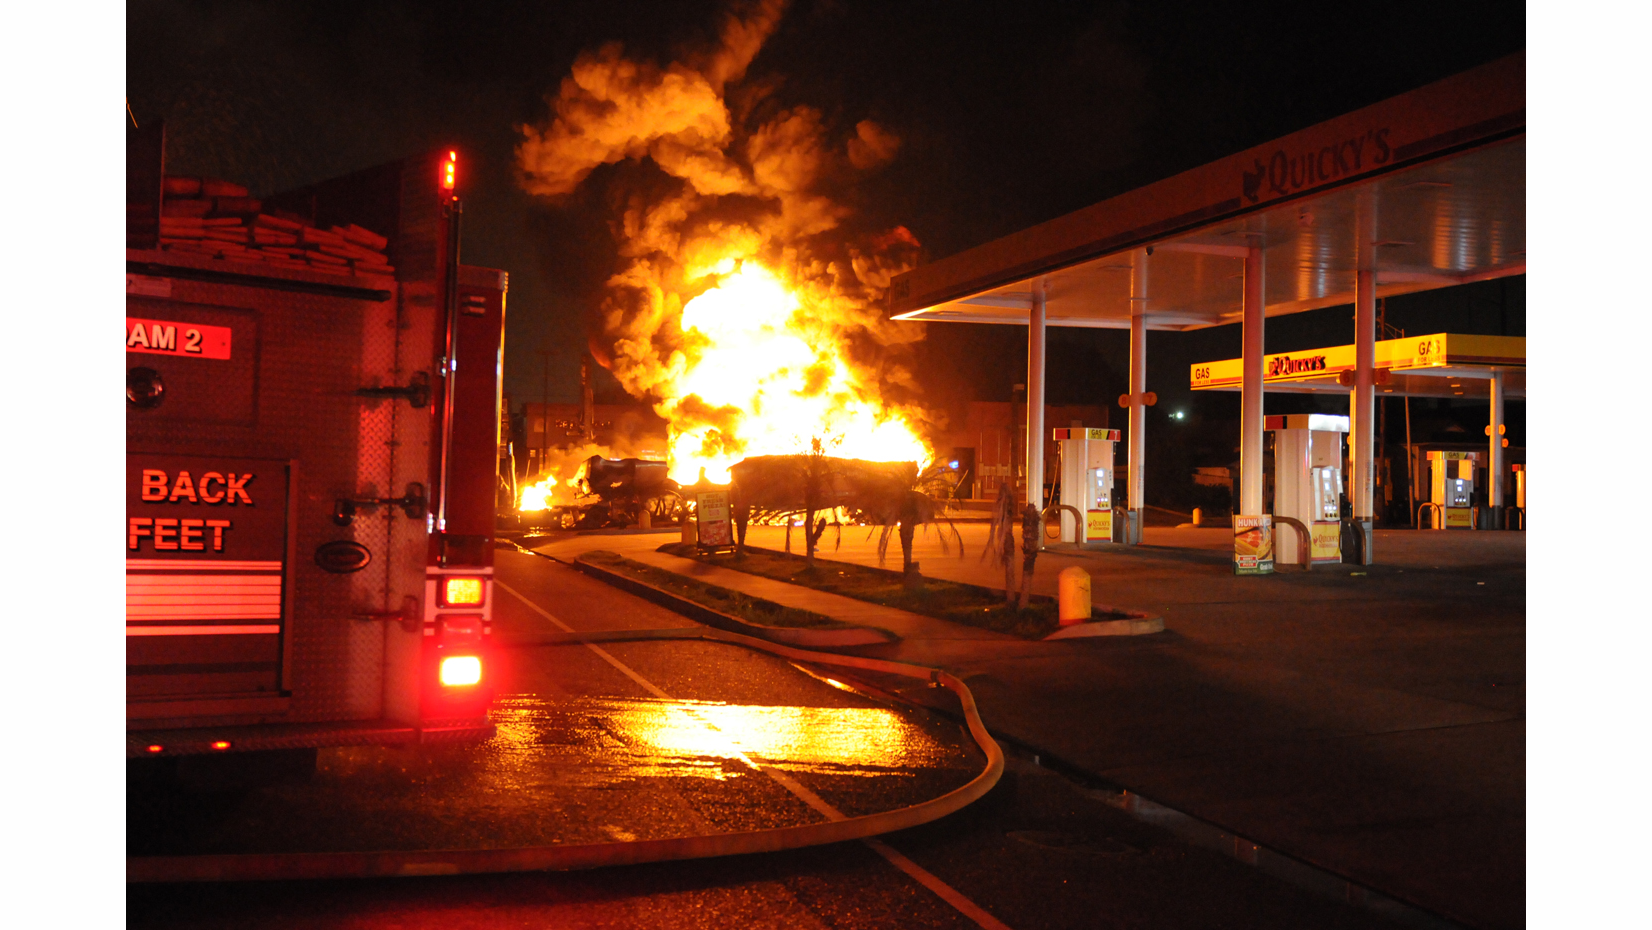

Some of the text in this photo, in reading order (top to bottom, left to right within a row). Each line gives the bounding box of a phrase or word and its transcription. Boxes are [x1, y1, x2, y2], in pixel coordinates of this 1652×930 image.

[1268, 127, 1391, 195] QUICKY'S
[184, 328, 202, 353] 2
[1195, 367, 1210, 380] GAS
[141, 469, 254, 505] BACK
[129, 517, 232, 552] FEET
[1238, 518, 1258, 527] HUNK
